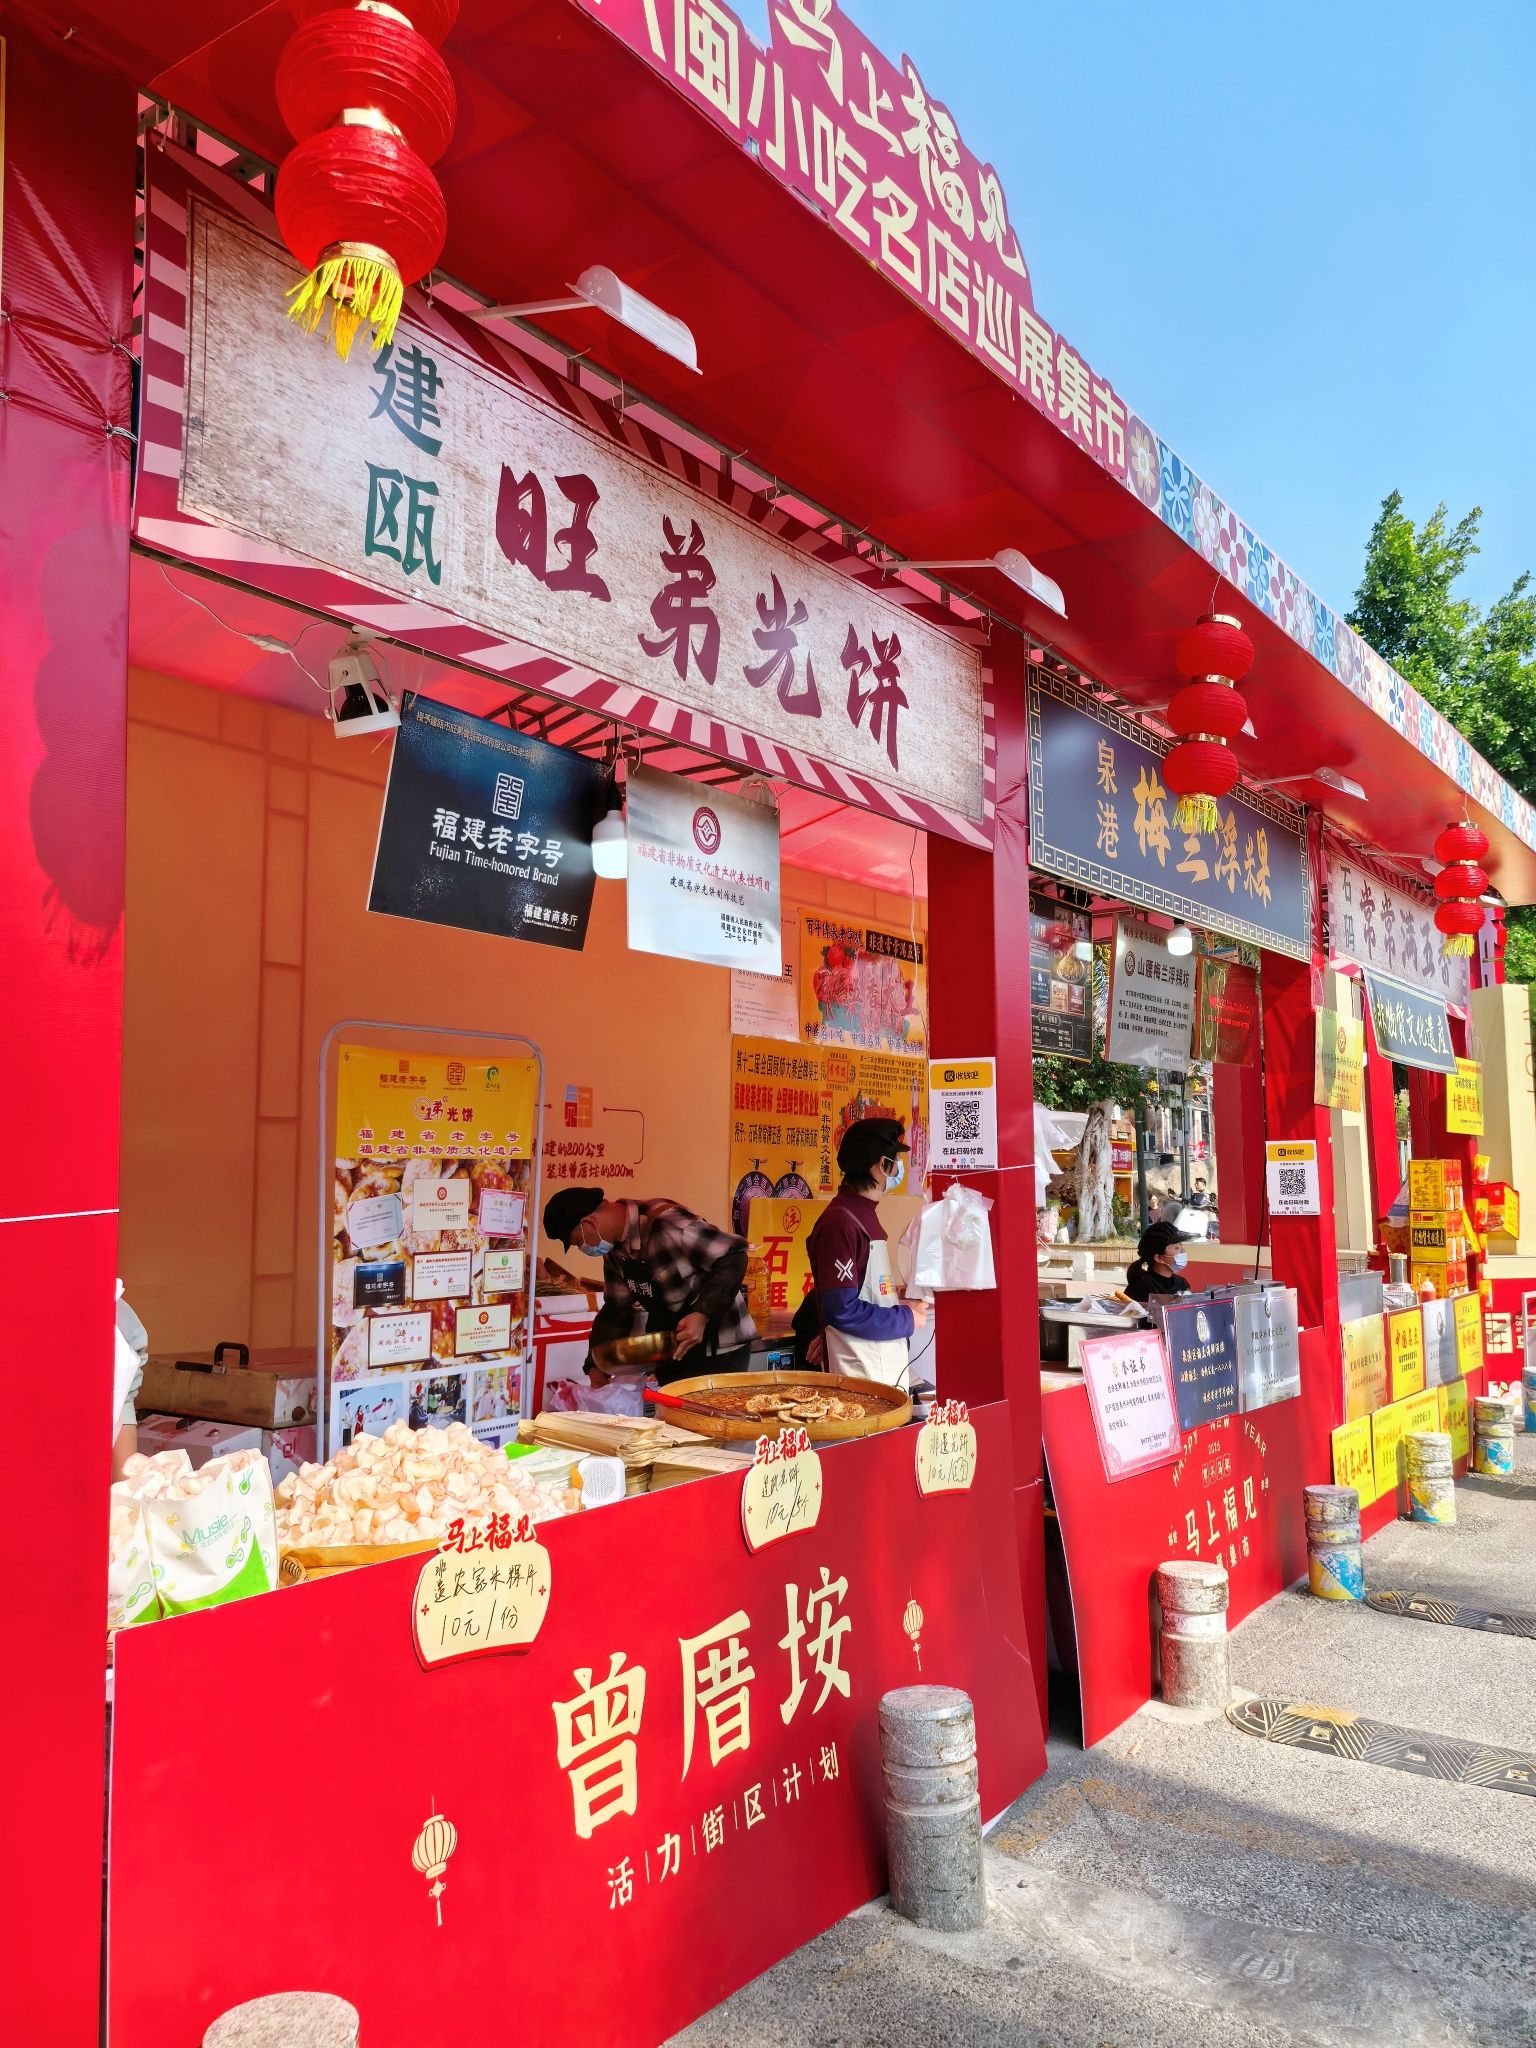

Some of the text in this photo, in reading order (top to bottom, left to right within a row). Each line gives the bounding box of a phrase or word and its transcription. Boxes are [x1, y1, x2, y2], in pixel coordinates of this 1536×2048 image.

[364, 341, 446, 587] 建瓯
[495, 461, 911, 773] 旺弟光饼
[1095, 737, 1120, 860] 泉港
[431, 808, 565, 869] 福建老字号
[430, 841, 560, 887] Fujian Time-honored Brand
[637, 842, 771, 893] 福建省非物质文化遗产代表性项目
[523, 903, 579, 928] 福建省商务厅
[1340, 864, 1355, 954] 石码
[379, 1074, 427, 1086] 福建老字号
[956, 1070, 980, 1080] 收钱吧
[358, 1129, 520, 1143] 福建省老字号
[358, 1144, 523, 1157] 福建省非物质文化遗产
[942, 1147, 984, 1156] 在此扫码付款
[755, 1427, 812, 1465] 马上福见
[1207, 1440, 1221, 1455] 2026
[1244, 1420, 1266, 1457] YEAR
[441, 1511, 538, 1555] 马上福见
[1184, 1475, 1258, 1557] 马上福见
[440, 1599, 520, 1647] 10元/份
[551, 1566, 853, 1840] 曾厝垵
